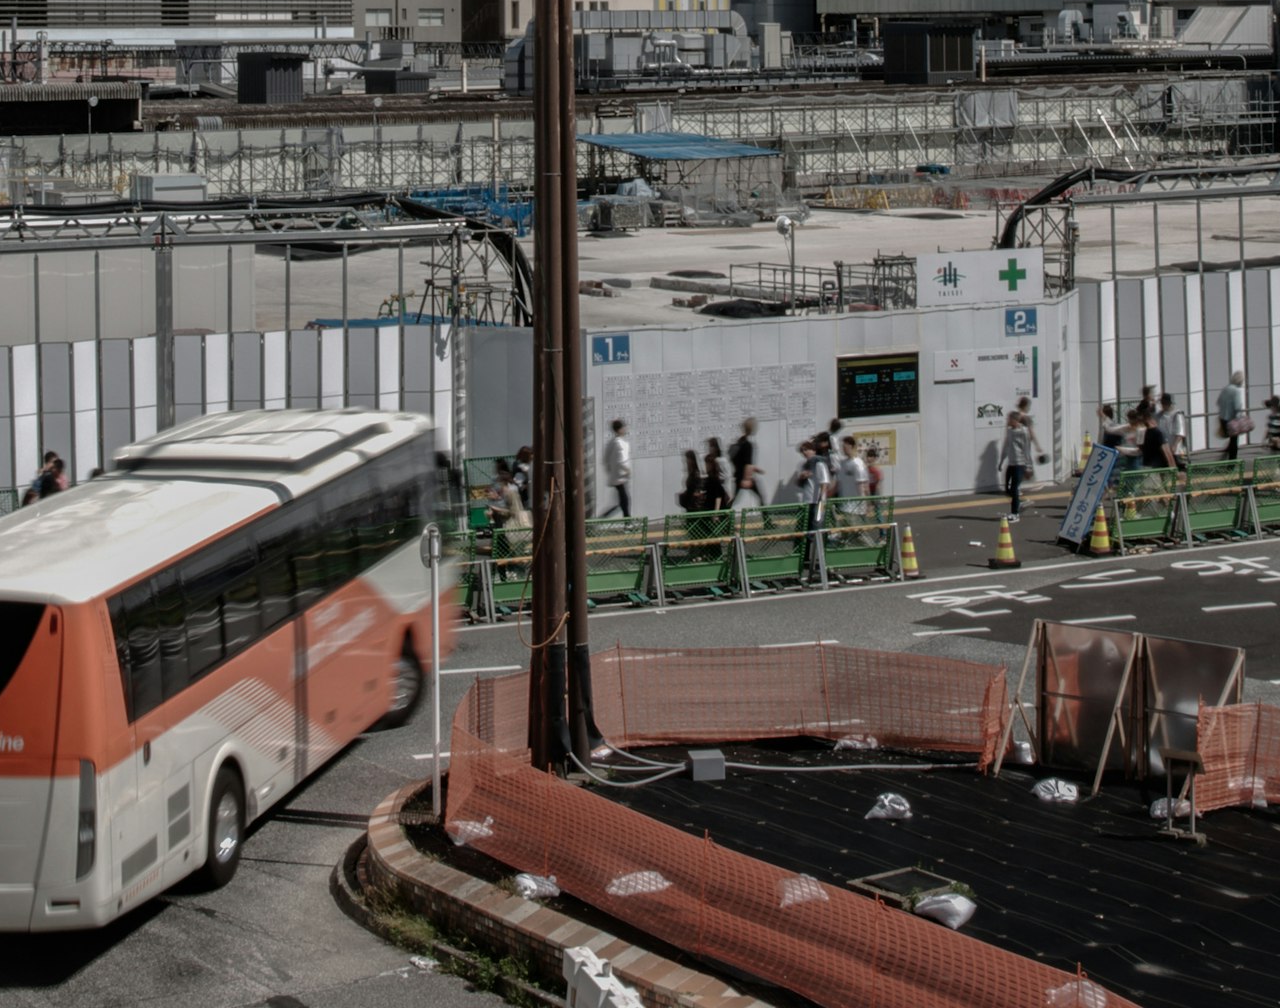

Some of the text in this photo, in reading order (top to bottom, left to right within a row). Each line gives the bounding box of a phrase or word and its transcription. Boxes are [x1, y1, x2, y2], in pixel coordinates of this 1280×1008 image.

[1014, 311, 1026, 333] 2
[605, 337, 614, 361] 1
[1067, 451, 1108, 538] タクシーおりば
